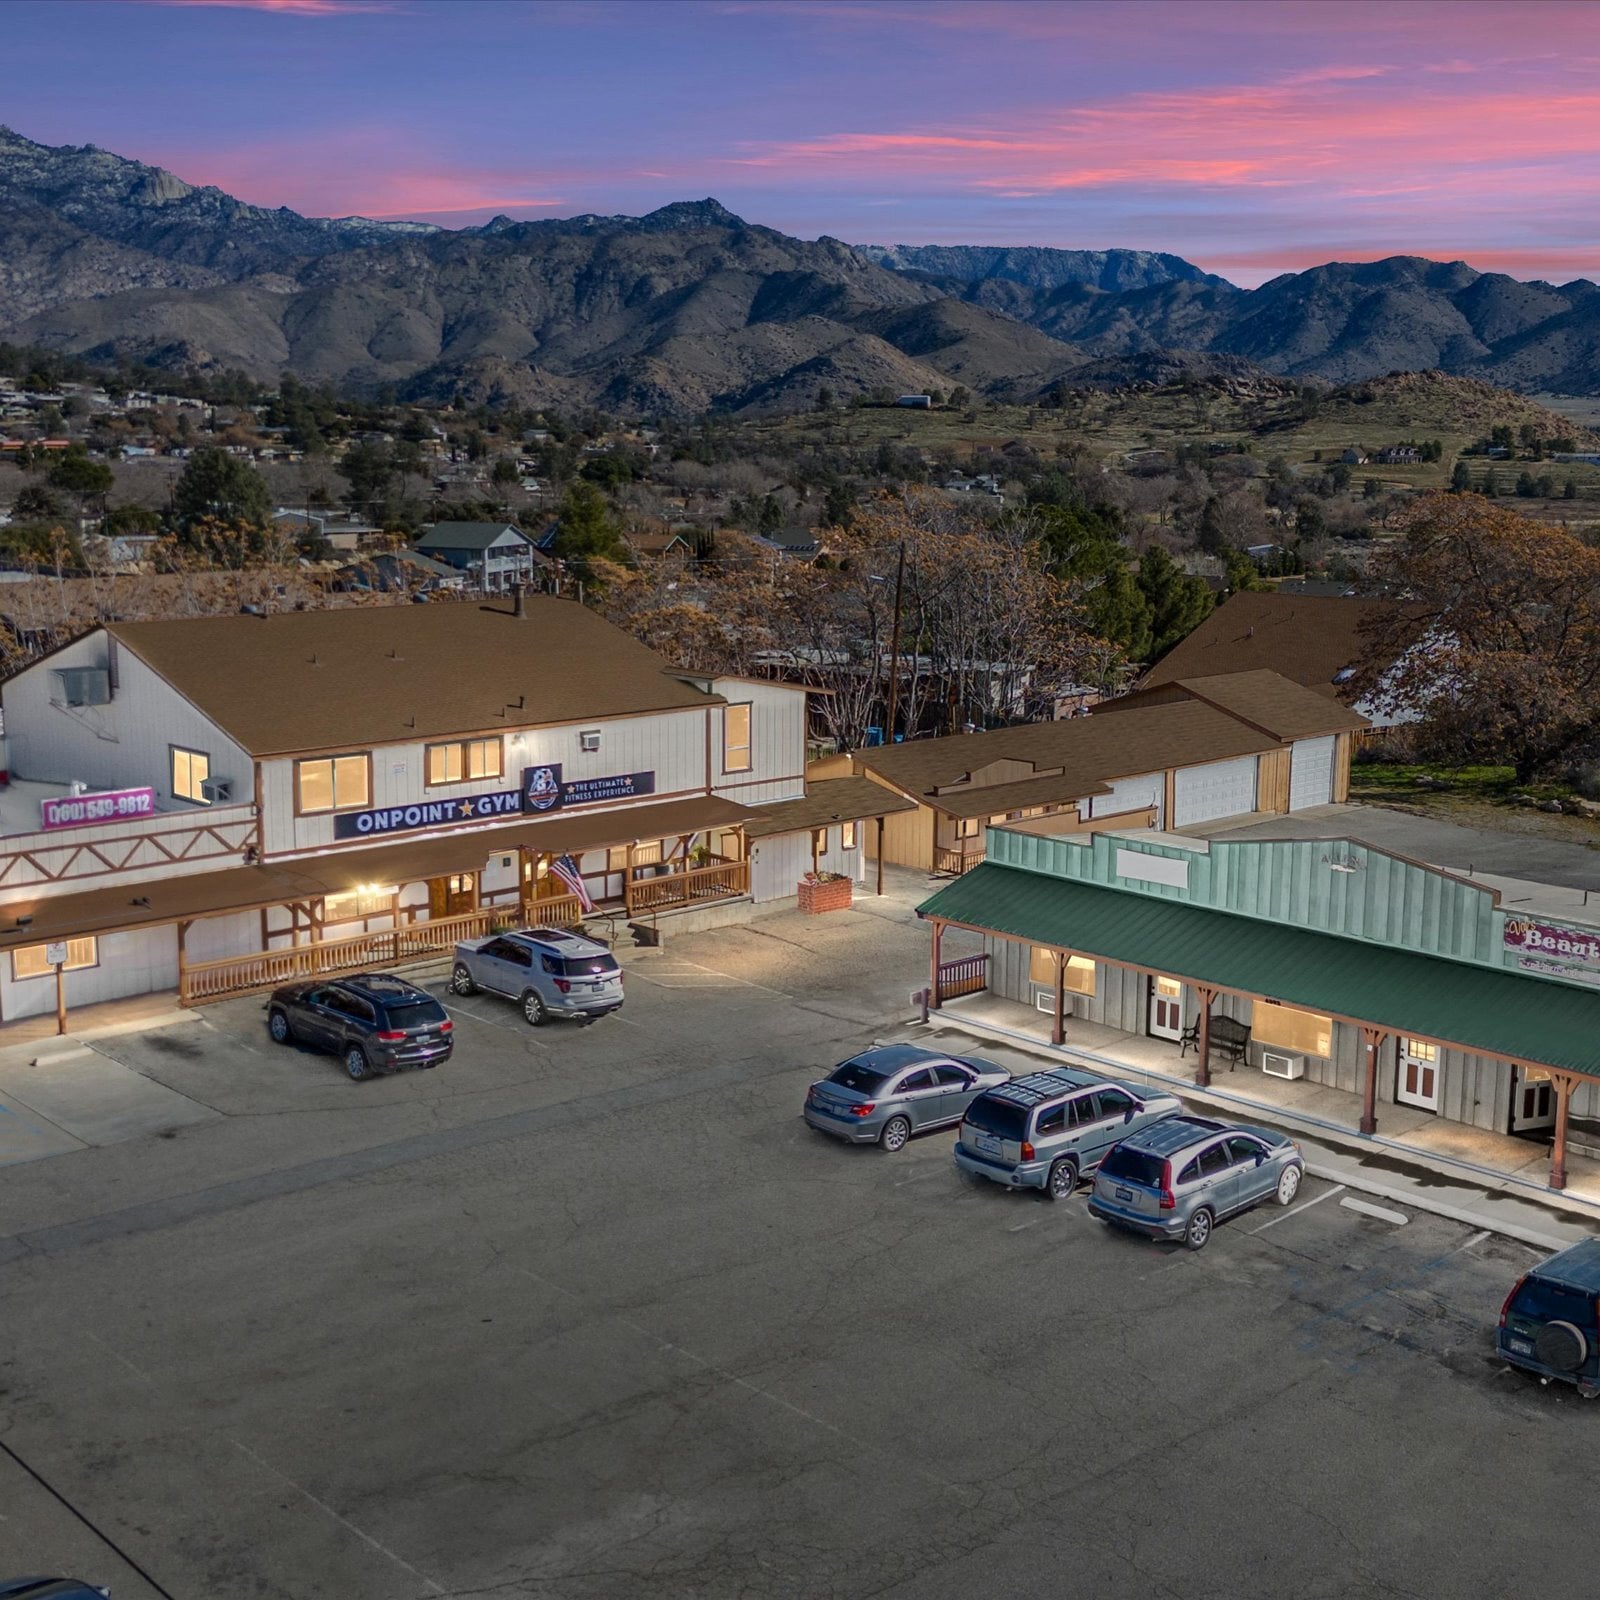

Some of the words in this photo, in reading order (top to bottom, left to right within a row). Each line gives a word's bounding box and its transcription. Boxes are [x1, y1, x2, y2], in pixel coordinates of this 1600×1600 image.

[564, 791, 592, 802] FITNESS
[594, 786, 635, 799] EXPERIENCE
[575, 784, 588, 792] THE
[589, 778, 624, 790] ULTIMATE
[87, 794, 150, 819] 549-9812
[356, 802, 456, 832] ONPOINT
[477, 793, 519, 814] GYM
